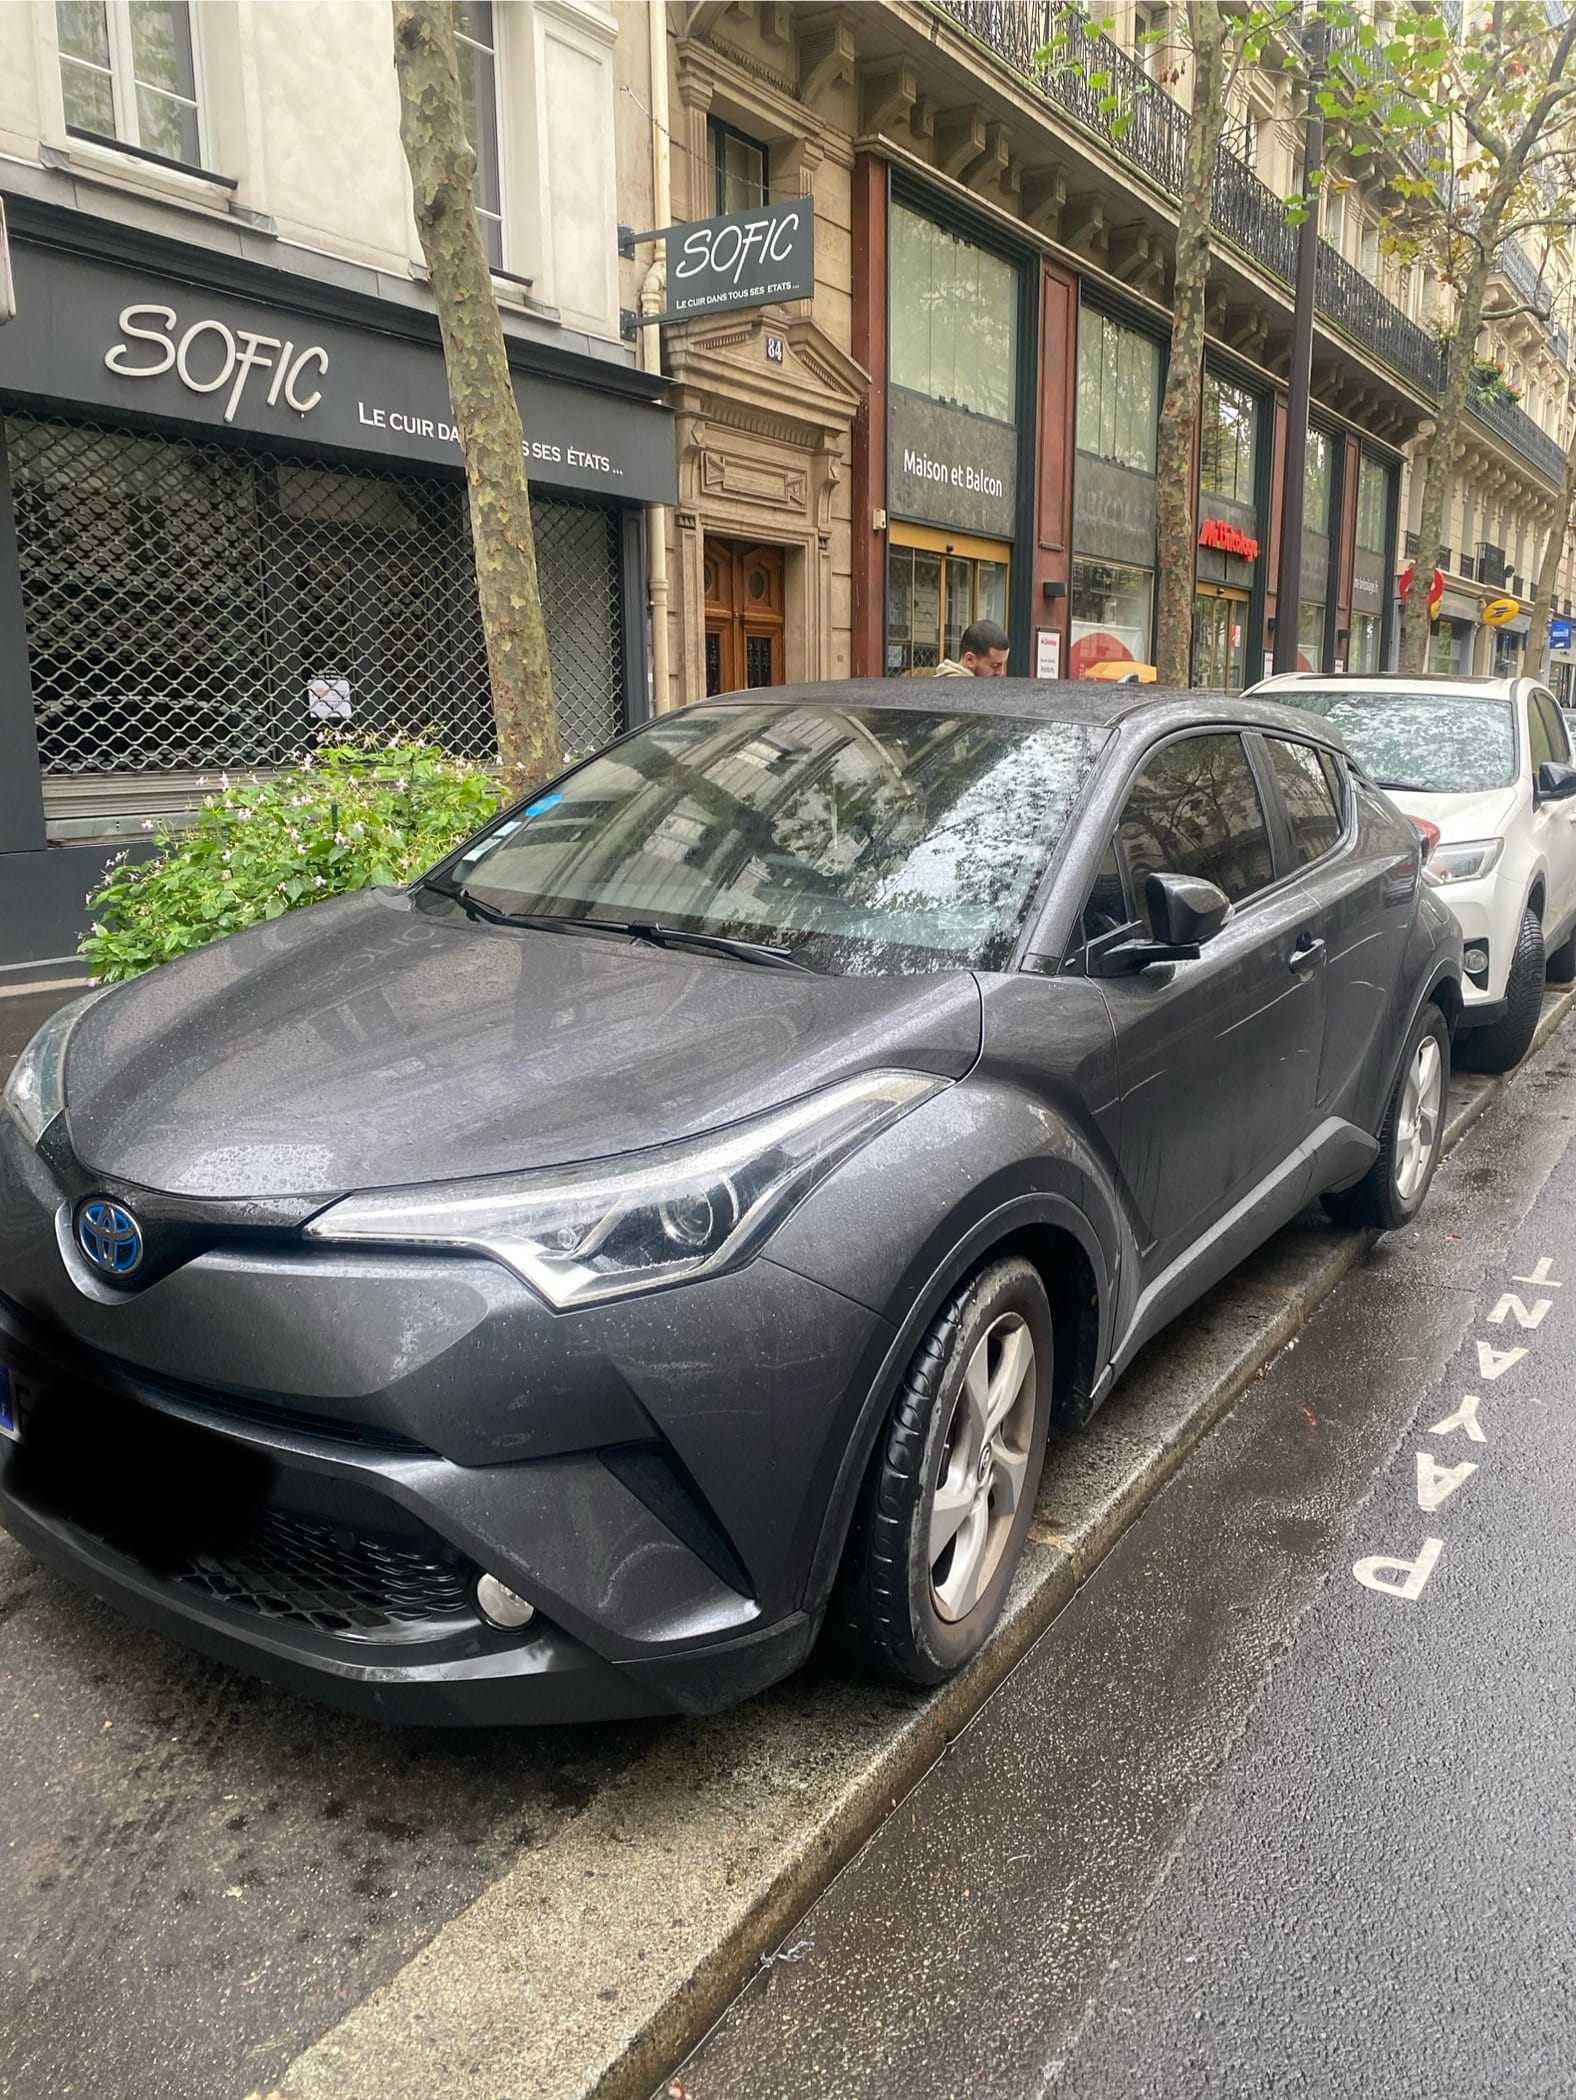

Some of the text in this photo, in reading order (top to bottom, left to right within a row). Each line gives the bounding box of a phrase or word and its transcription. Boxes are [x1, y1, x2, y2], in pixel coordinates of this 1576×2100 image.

[675, 213, 800, 284] SOFIC
[688, 296, 707, 308] CUIR
[707, 293, 728, 304] DANS
[728, 288, 749, 300] TOUS
[750, 286, 765, 297] SES
[104, 304, 329, 423] SOFIC
[767, 337, 783, 361] 84
[388, 412, 435, 439] CUIR
[532, 441, 562, 463] SES
[903, 449, 1003, 497] Maison et Balcon
[1352, 1257, 1563, 1601] PAYANT
